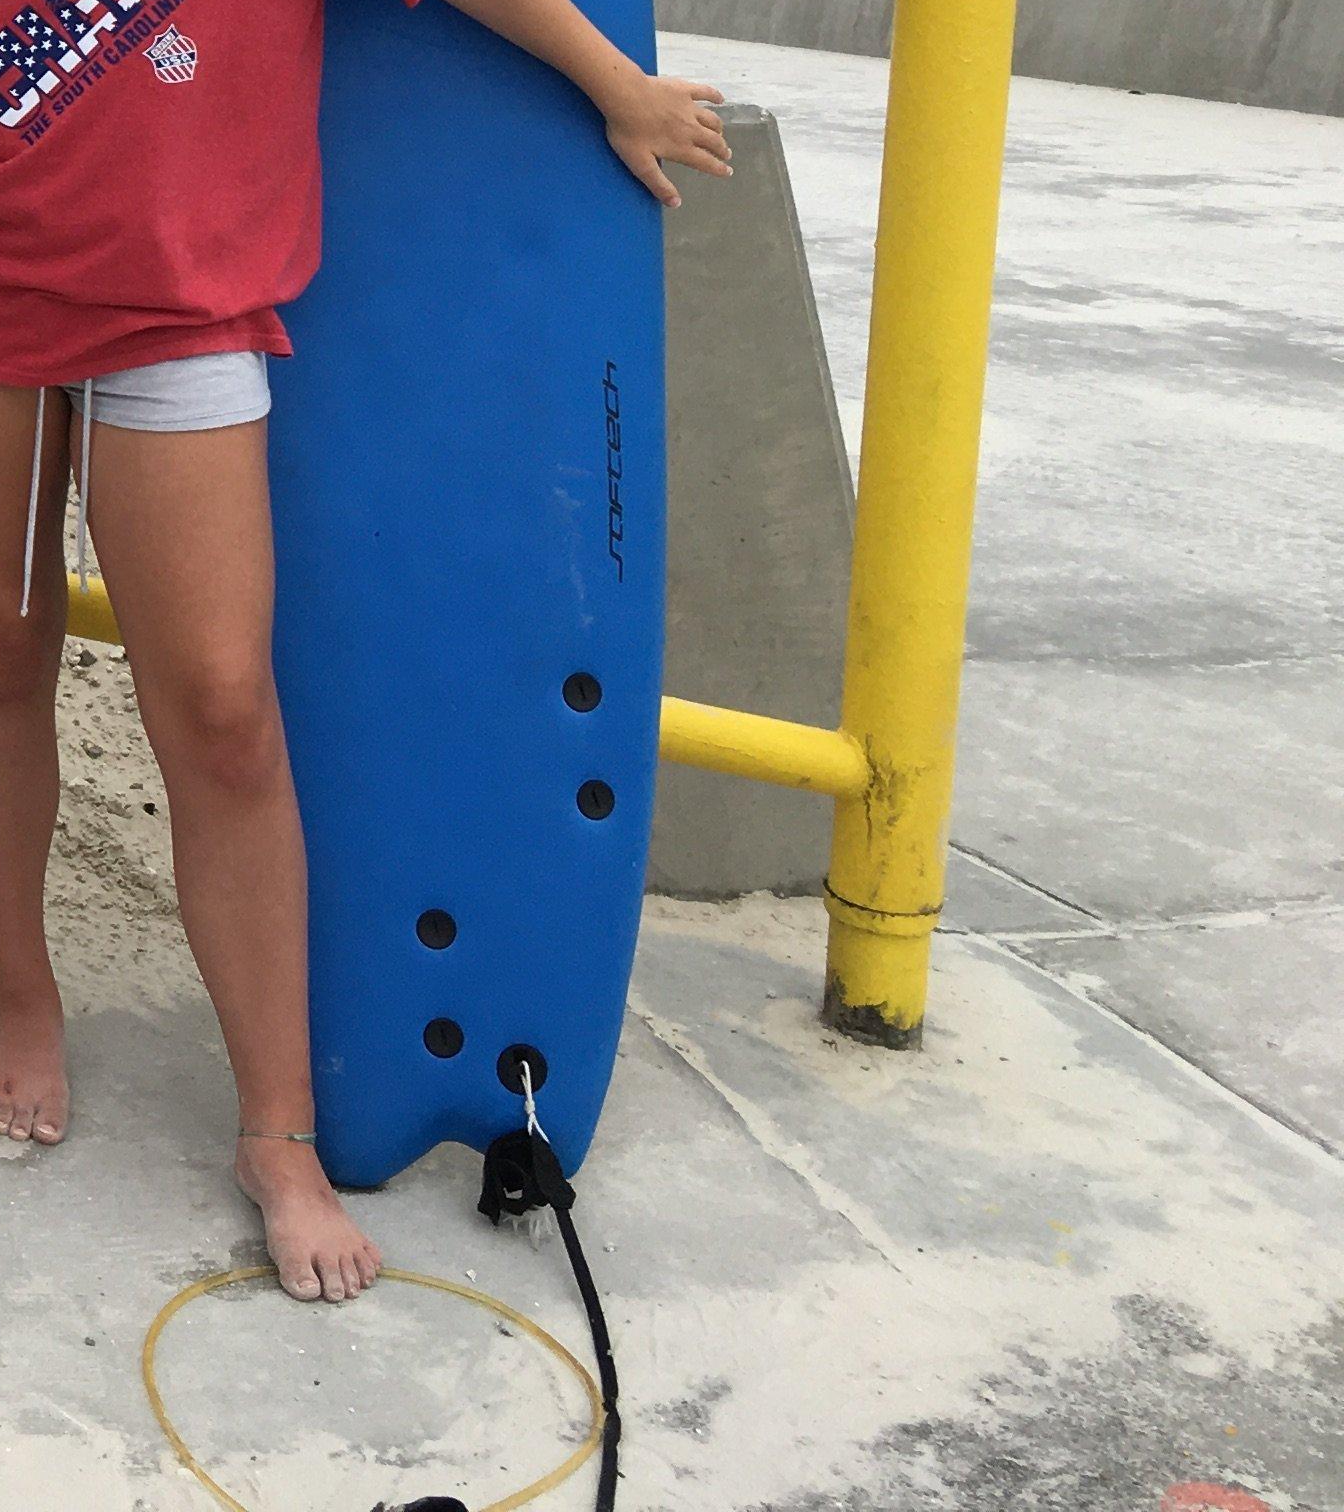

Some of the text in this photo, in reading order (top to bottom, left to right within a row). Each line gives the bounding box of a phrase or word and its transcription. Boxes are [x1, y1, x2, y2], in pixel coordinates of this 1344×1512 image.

[159, 52, 192, 67] USA
[19, 114, 53, 148] THE
[52, 63, 108, 118] SOUTH
